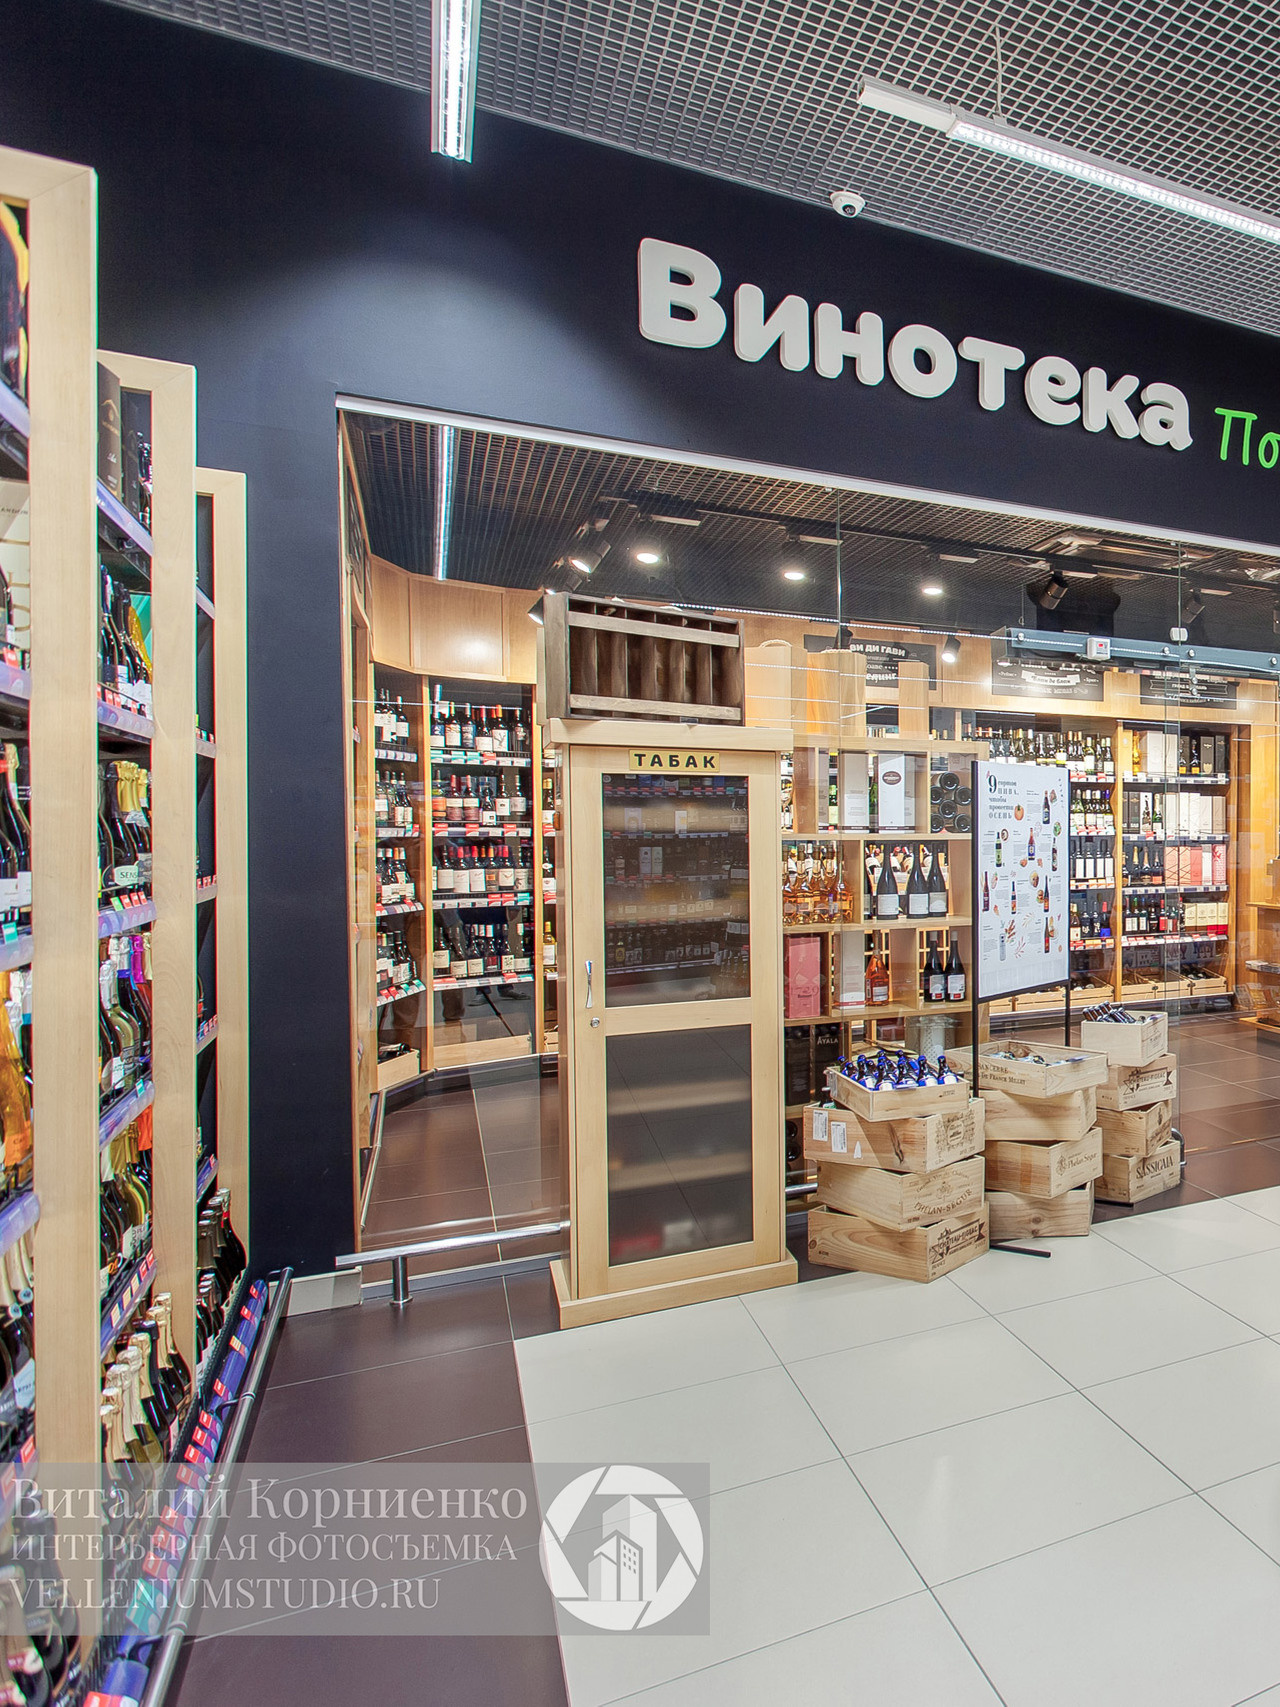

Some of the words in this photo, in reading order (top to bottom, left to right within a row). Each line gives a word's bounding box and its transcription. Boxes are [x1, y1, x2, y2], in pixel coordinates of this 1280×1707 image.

[638, 237, 1193, 451] Винотека
[634, 753, 716, 769] ТАБАК
[988, 774, 997, 793] 9
[817, 1036, 839, 1046] AYALA
